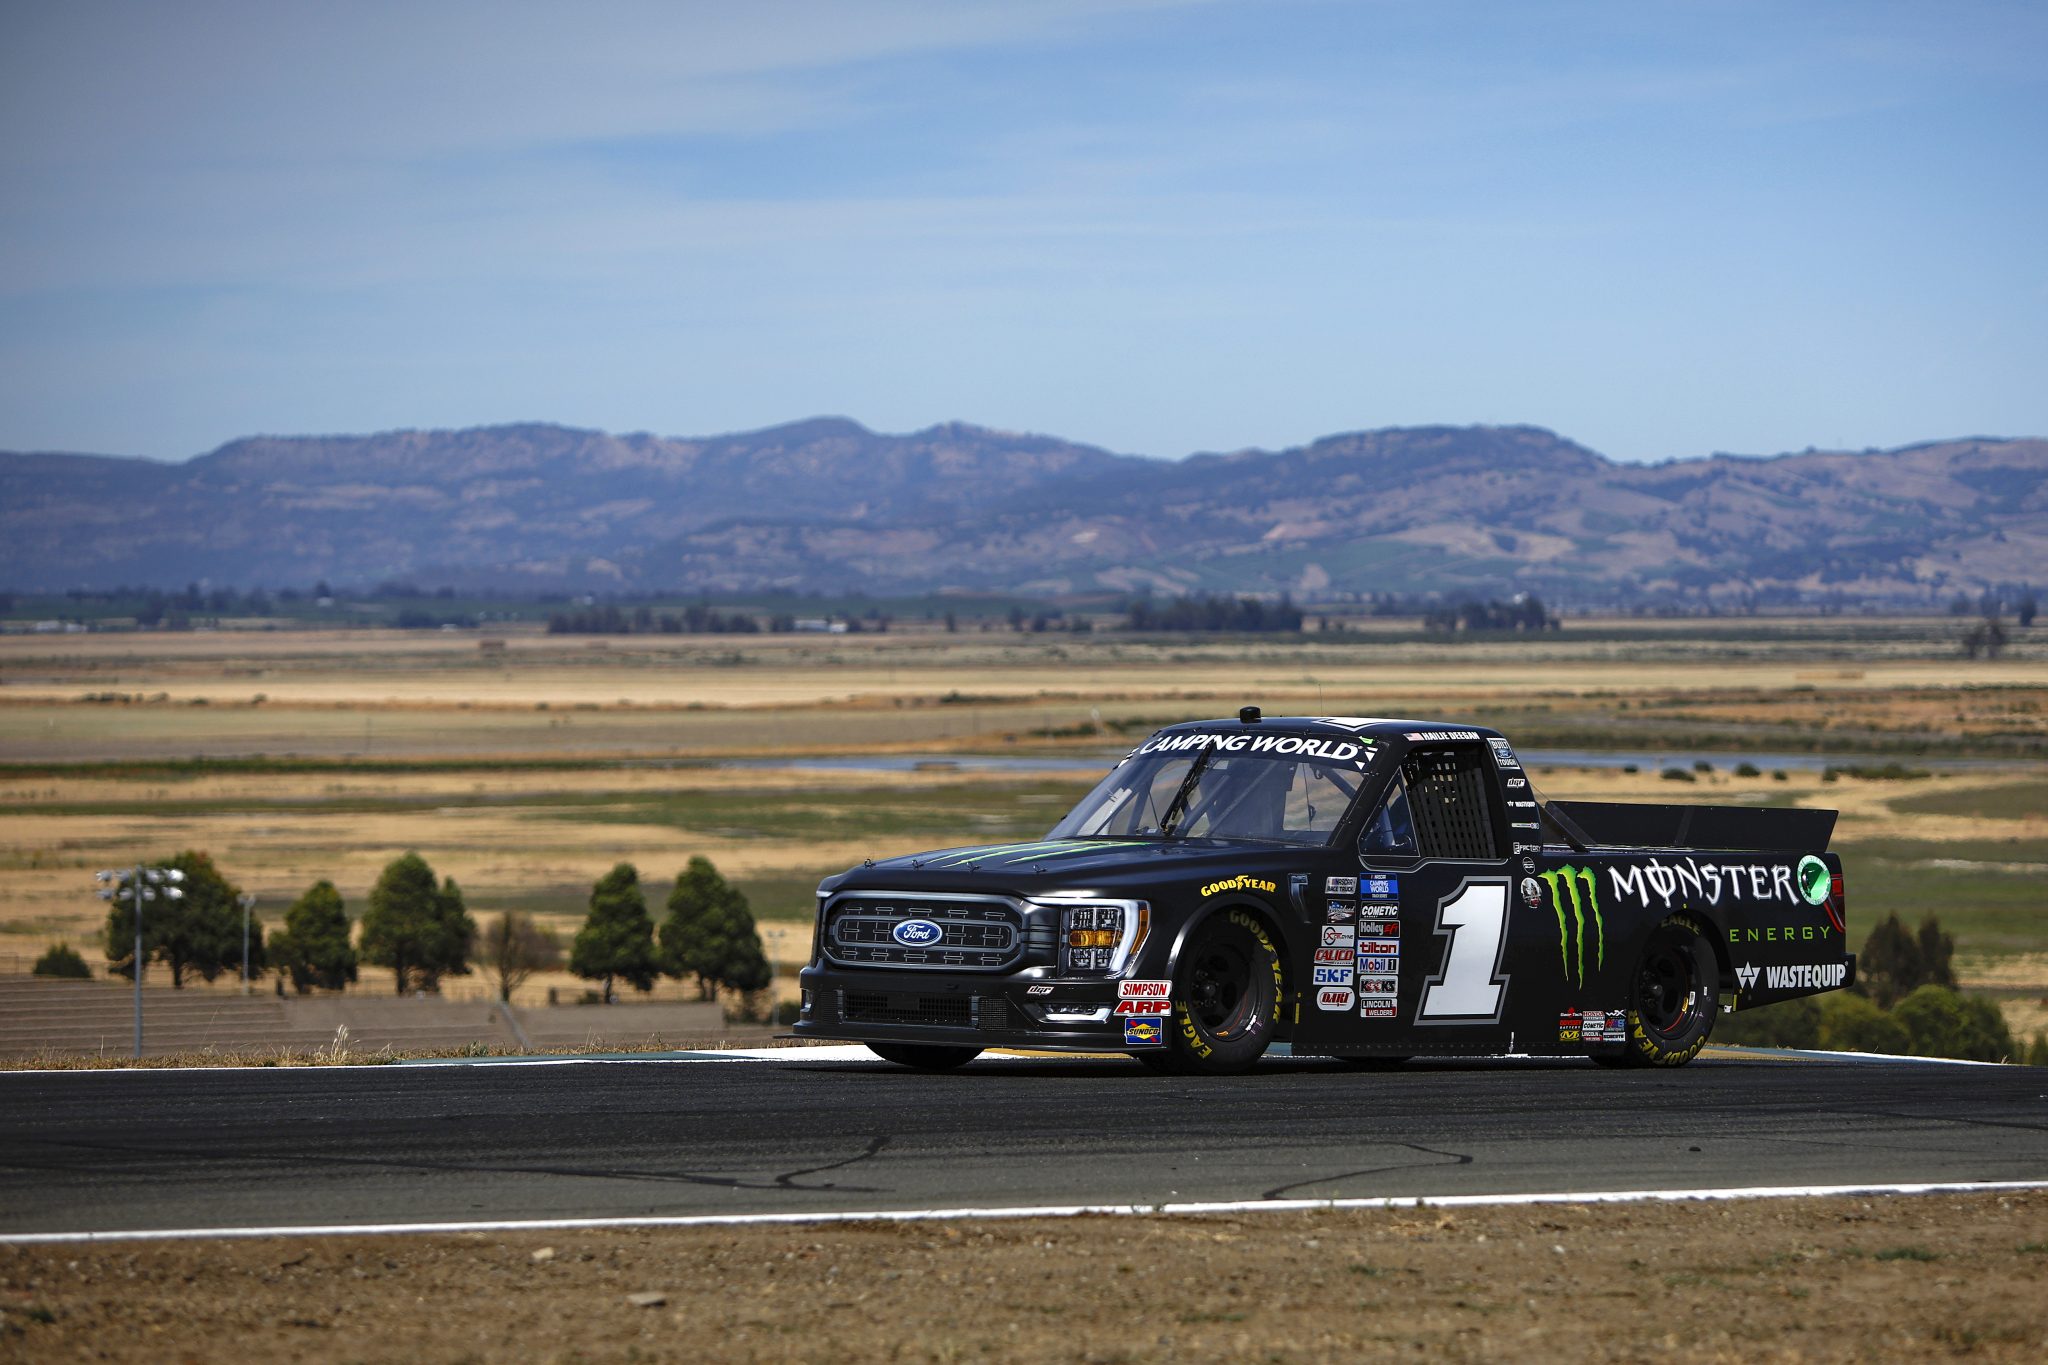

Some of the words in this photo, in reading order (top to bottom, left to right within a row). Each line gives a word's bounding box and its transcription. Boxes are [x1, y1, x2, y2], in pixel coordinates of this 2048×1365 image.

[1421, 732, 1450, 740] HAILIE
[1448, 731, 1480, 740] DEEGAN
[1140, 734, 1252, 755] CAMPING
[1250, 735, 1359, 760] WORLD
[1200, 875, 1278, 897] GOODYEAR
[1608, 856, 1799, 908] MONSTER
[1361, 905, 1398, 916] COMETIC
[903, 924, 931, 940] Ford
[1360, 921, 1384, 936] Holley
[1729, 926, 1830, 942] ENERGY
[1315, 948, 1354, 961] CALICO
[1360, 942, 1397, 954] tilton
[1416, 878, 1510, 1023] 1
[1360, 958, 1386, 971] Mobil
[1314, 968, 1353, 983] SKF
[1766, 963, 1847, 988] WASTEQUIP
[1122, 983, 1168, 996] SIMPSON
[1115, 1000, 1171, 1014] ARP
[1362, 1000, 1391, 1008] LINCOLN
[1175, 1000, 1213, 1060] EAGLE
